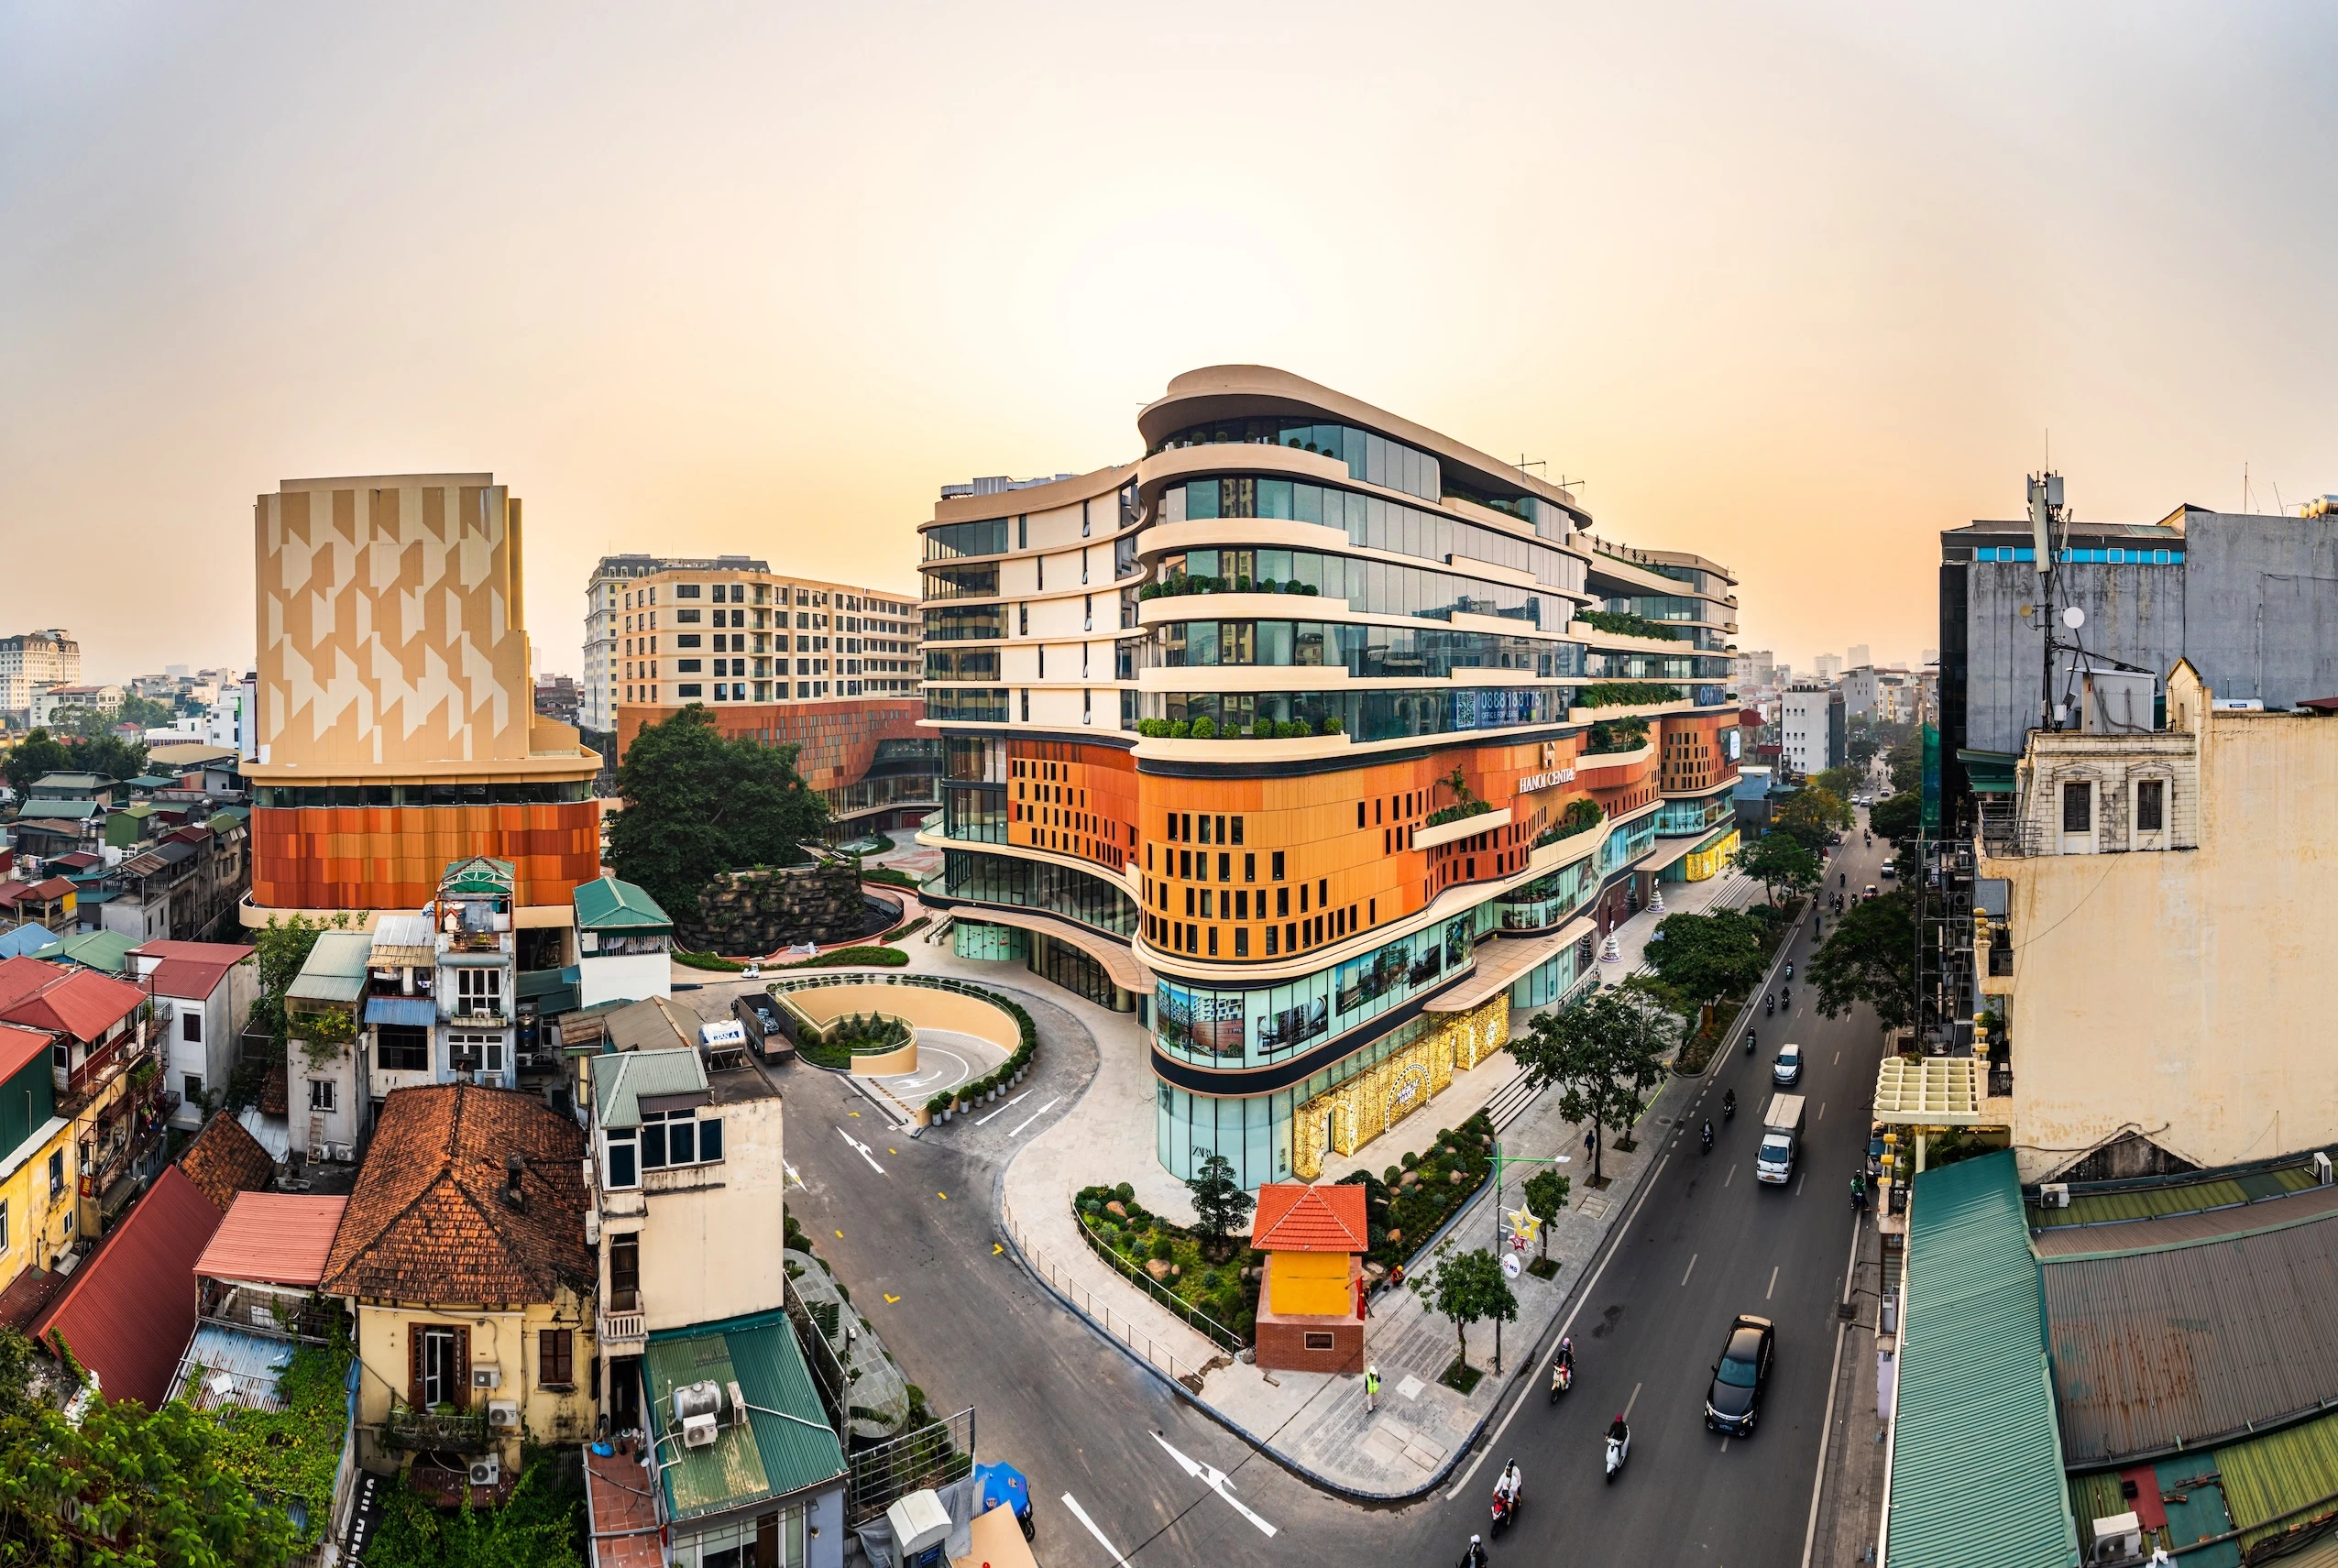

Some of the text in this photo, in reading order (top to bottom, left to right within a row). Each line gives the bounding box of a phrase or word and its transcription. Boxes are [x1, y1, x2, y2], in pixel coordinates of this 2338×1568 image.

[1481, 711, 1497, 719] OFFICE
[1519, 767, 1575, 794] HANOI CENTRE
[1509, 1265, 1518, 1273] MB
